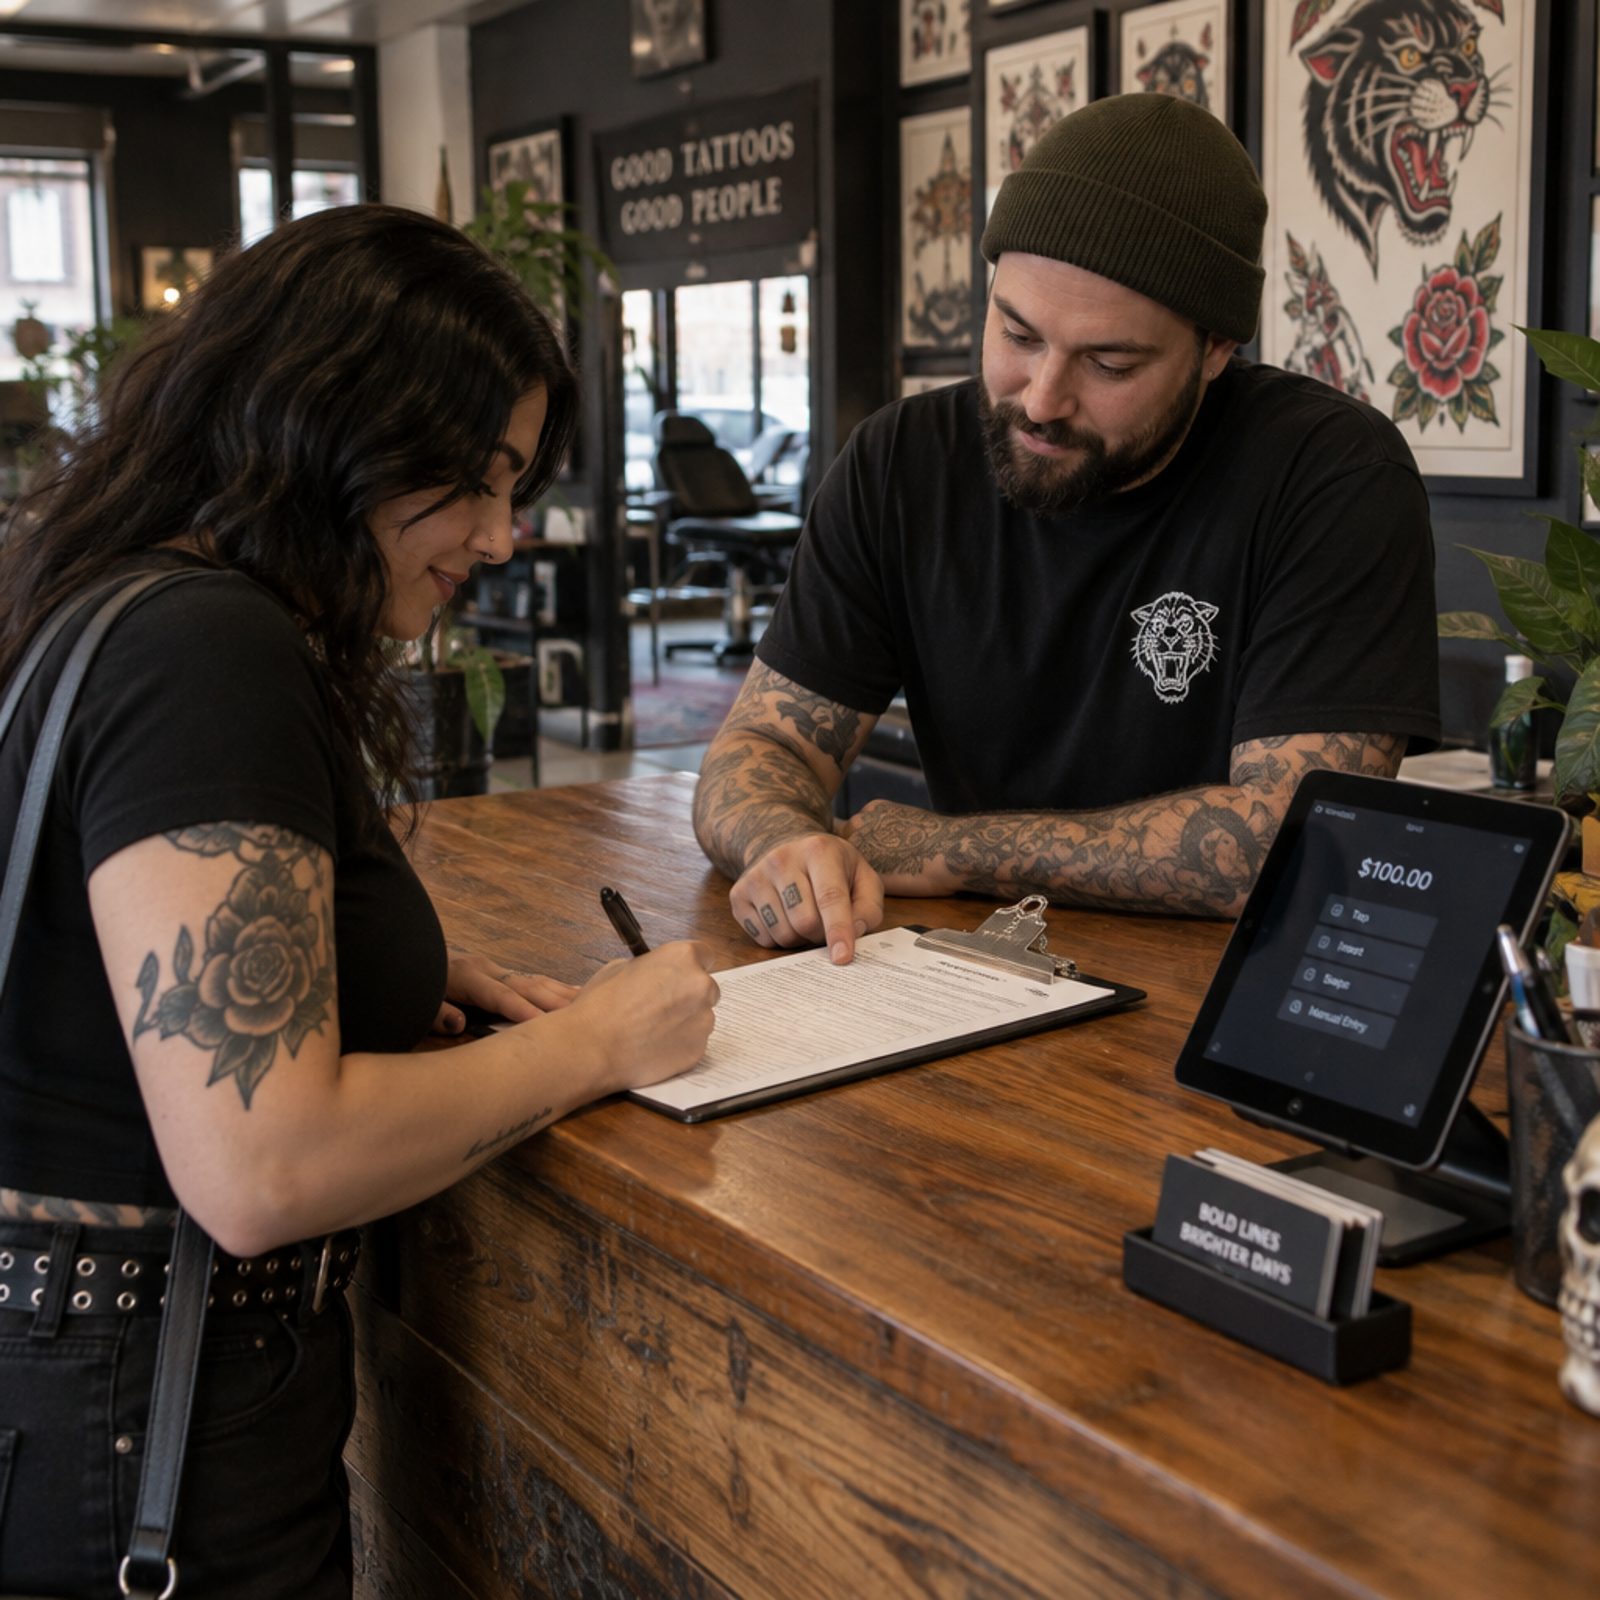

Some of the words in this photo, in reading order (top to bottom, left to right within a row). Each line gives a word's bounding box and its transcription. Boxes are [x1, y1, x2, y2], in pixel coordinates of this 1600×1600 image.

[611, 148, 673, 190] GOOD
[681, 121, 794, 176] TATTOOS
[621, 194, 684, 235] GOOD
[692, 178, 781, 224] PEOPLE
[1358, 857, 1433, 890] $100.00
[1342, 1016, 1368, 1034] Entry
[1180, 1222, 1249, 1267] BRIGHTER
[1251, 1252, 1292, 1286] DAYS
[1198, 1203, 1237, 1233] BOLD
[1238, 1219, 1281, 1252] LINES
